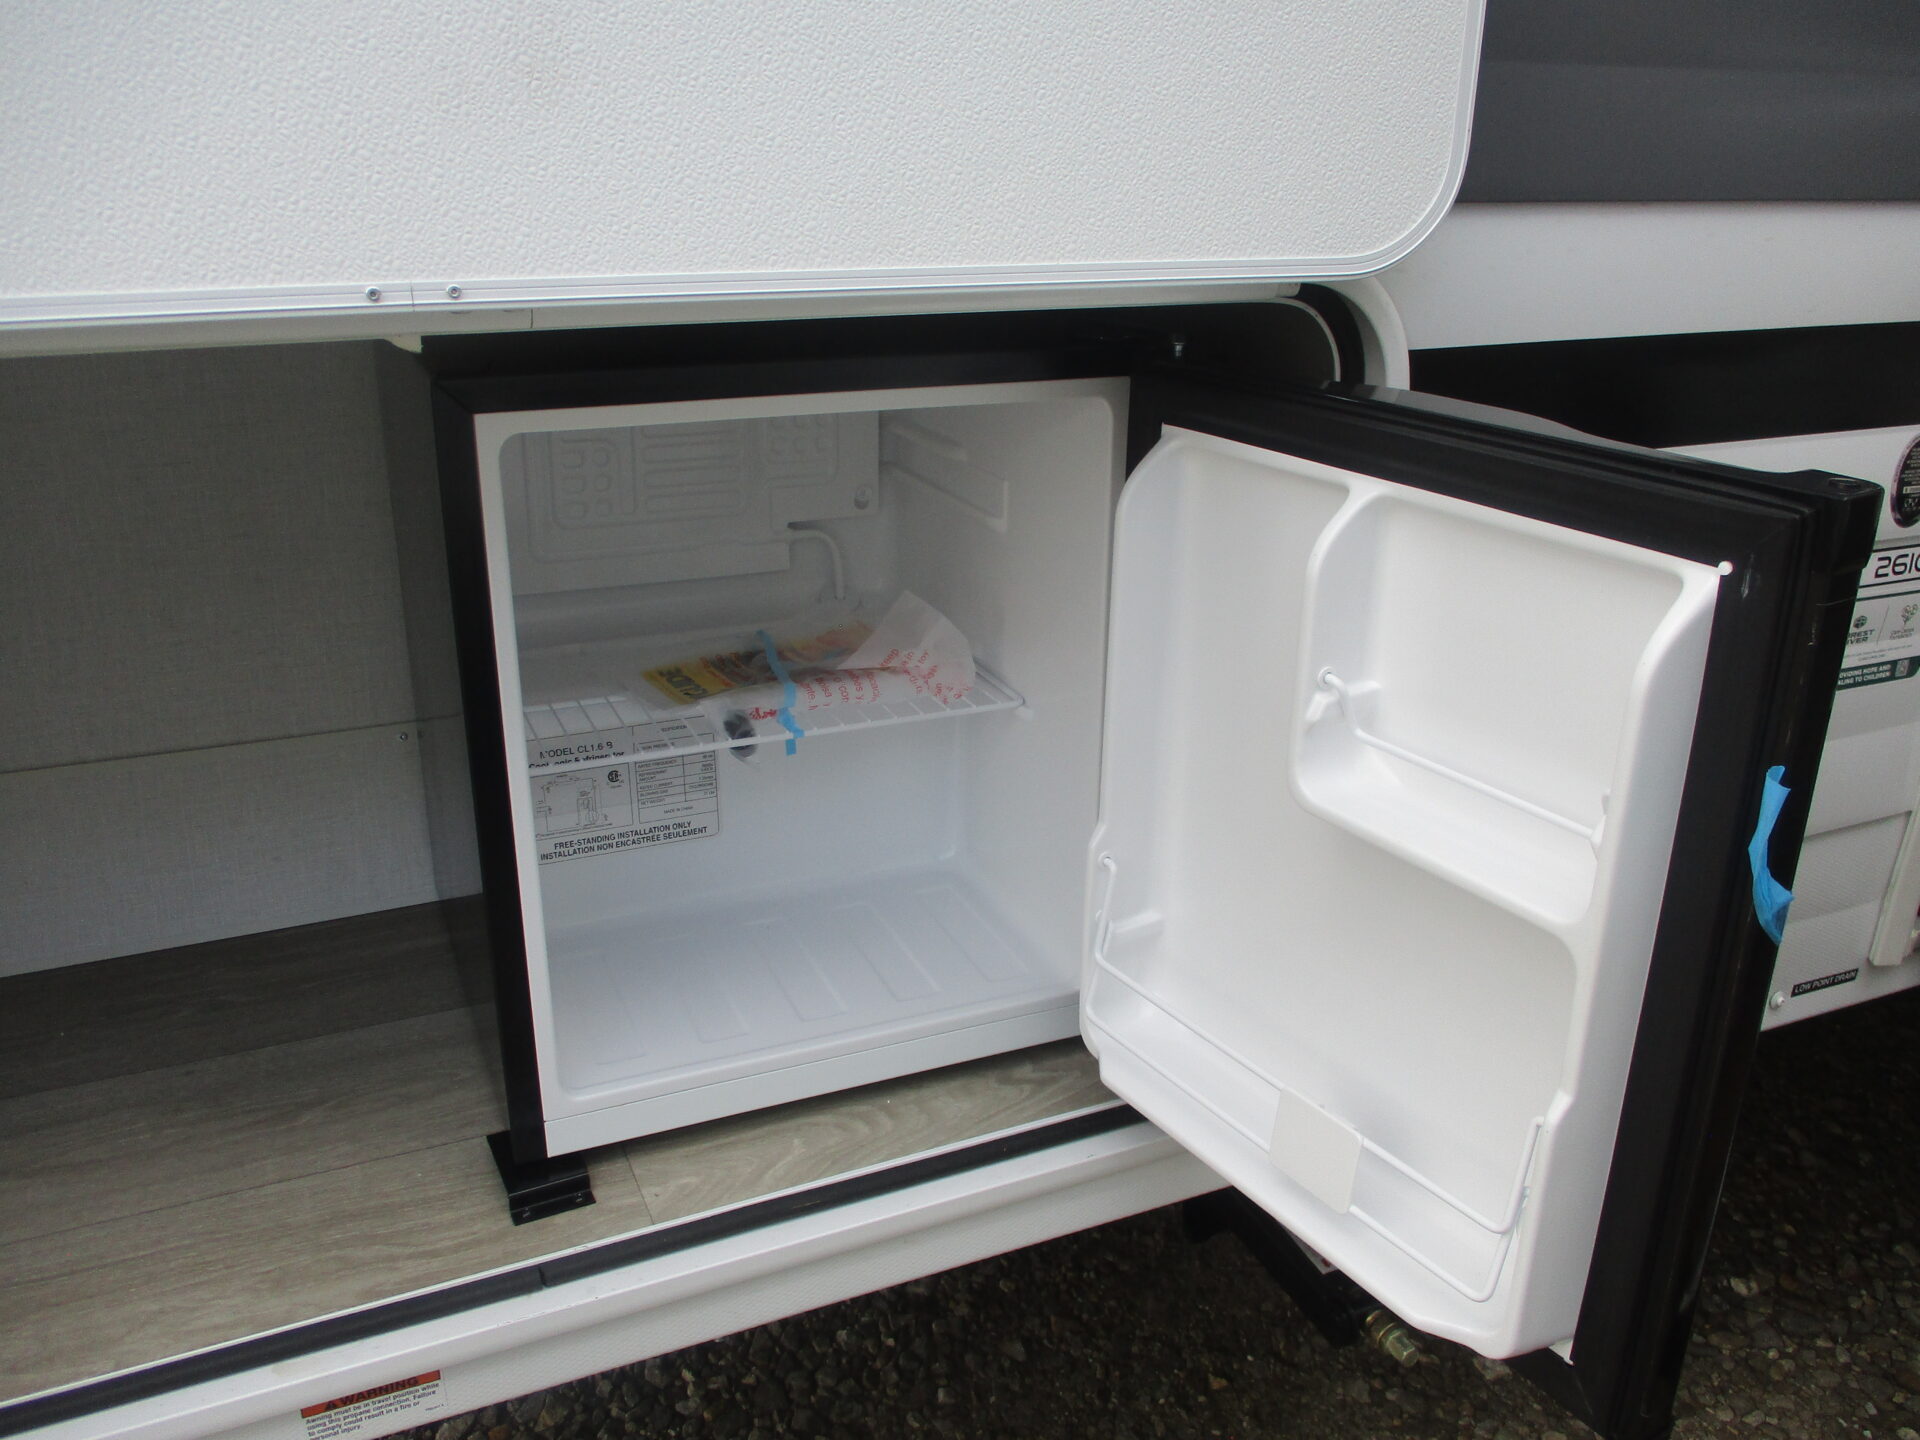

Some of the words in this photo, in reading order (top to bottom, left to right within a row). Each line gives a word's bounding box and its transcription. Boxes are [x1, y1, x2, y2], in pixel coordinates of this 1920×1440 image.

[540, 747, 574, 759] MODEL
[540, 844, 595, 860] INSTALLATION
[597, 842, 614, 852] NON
[663, 826, 708, 841] SEULEMENT
[554, 833, 616, 850] FREE-STANDING
[617, 824, 670, 840] INSTALLATION
[672, 820, 692, 830] ONLY
[1794, 982, 1811, 993] LOW
[1812, 976, 1833, 989] POINT
[1834, 971, 1857, 983] DRAIN
[306, 1413, 332, 1424] Awning
[334, 1408, 351, 1417] must
[372, 1395, 391, 1406] travel
[392, 1389, 419, 1401] position
[421, 1382, 439, 1392] while
[340, 1376, 418, 1406] WARNING
[307, 1421, 327, 1431] using
[328, 1416, 341, 1424] this
[343, 1409, 371, 1421] propane
[372, 1398, 410, 1411] connection.
[413, 1390, 436, 1400] Failure
[317, 1423, 342, 1434] comply
[344, 1416, 363, 1426] could
[364, 1411, 385, 1420] result
[400, 1402, 411, 1410] fire
